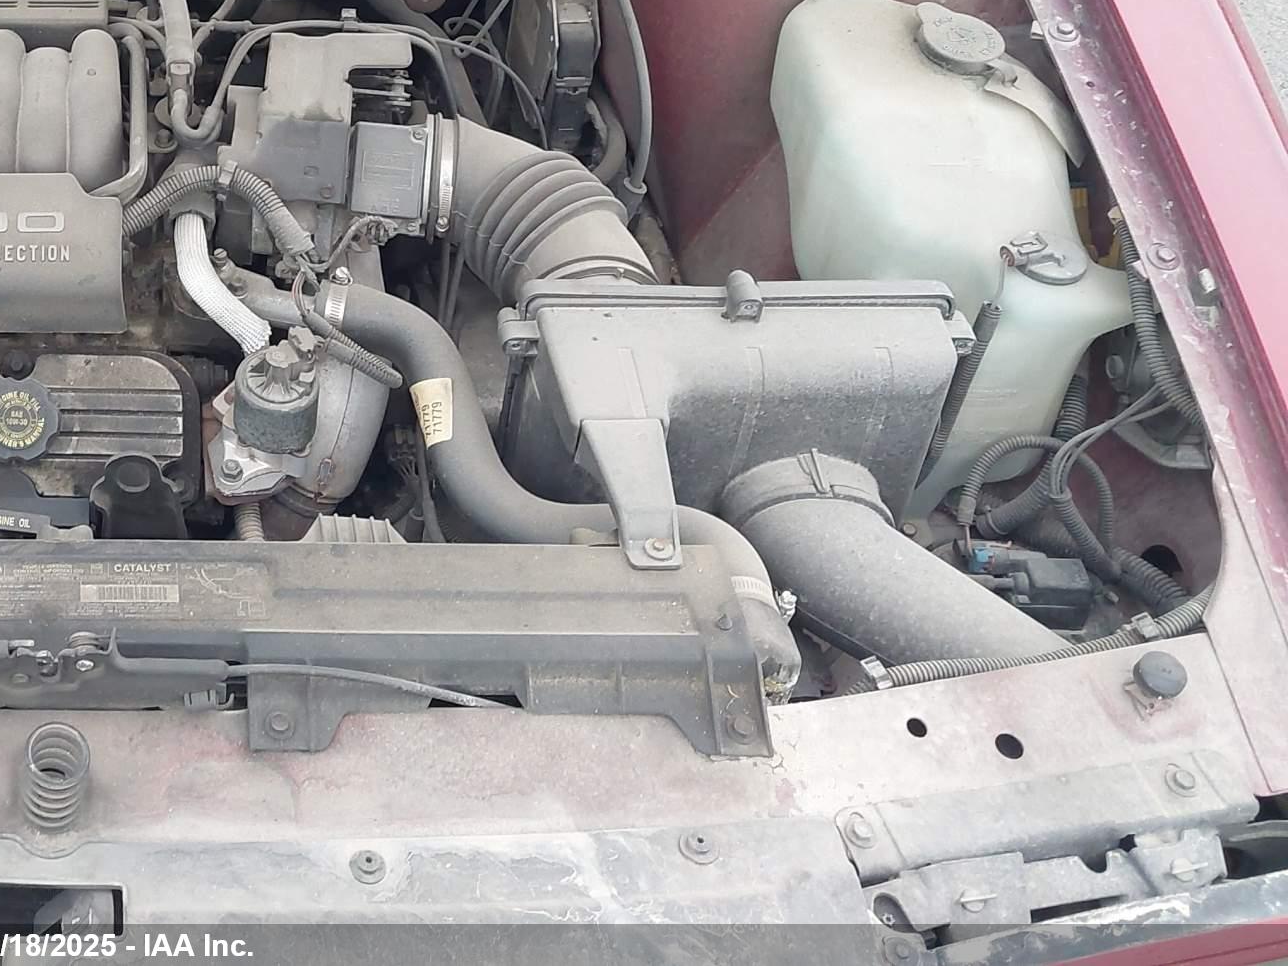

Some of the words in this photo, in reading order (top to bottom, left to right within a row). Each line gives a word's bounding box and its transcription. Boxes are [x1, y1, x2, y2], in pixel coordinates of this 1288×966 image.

[30, 397, 41, 412] FILL
[431, 401, 443, 435] 71779
[18, 518, 31, 529] OIL
[113, 563, 172, 573] CATALYST
